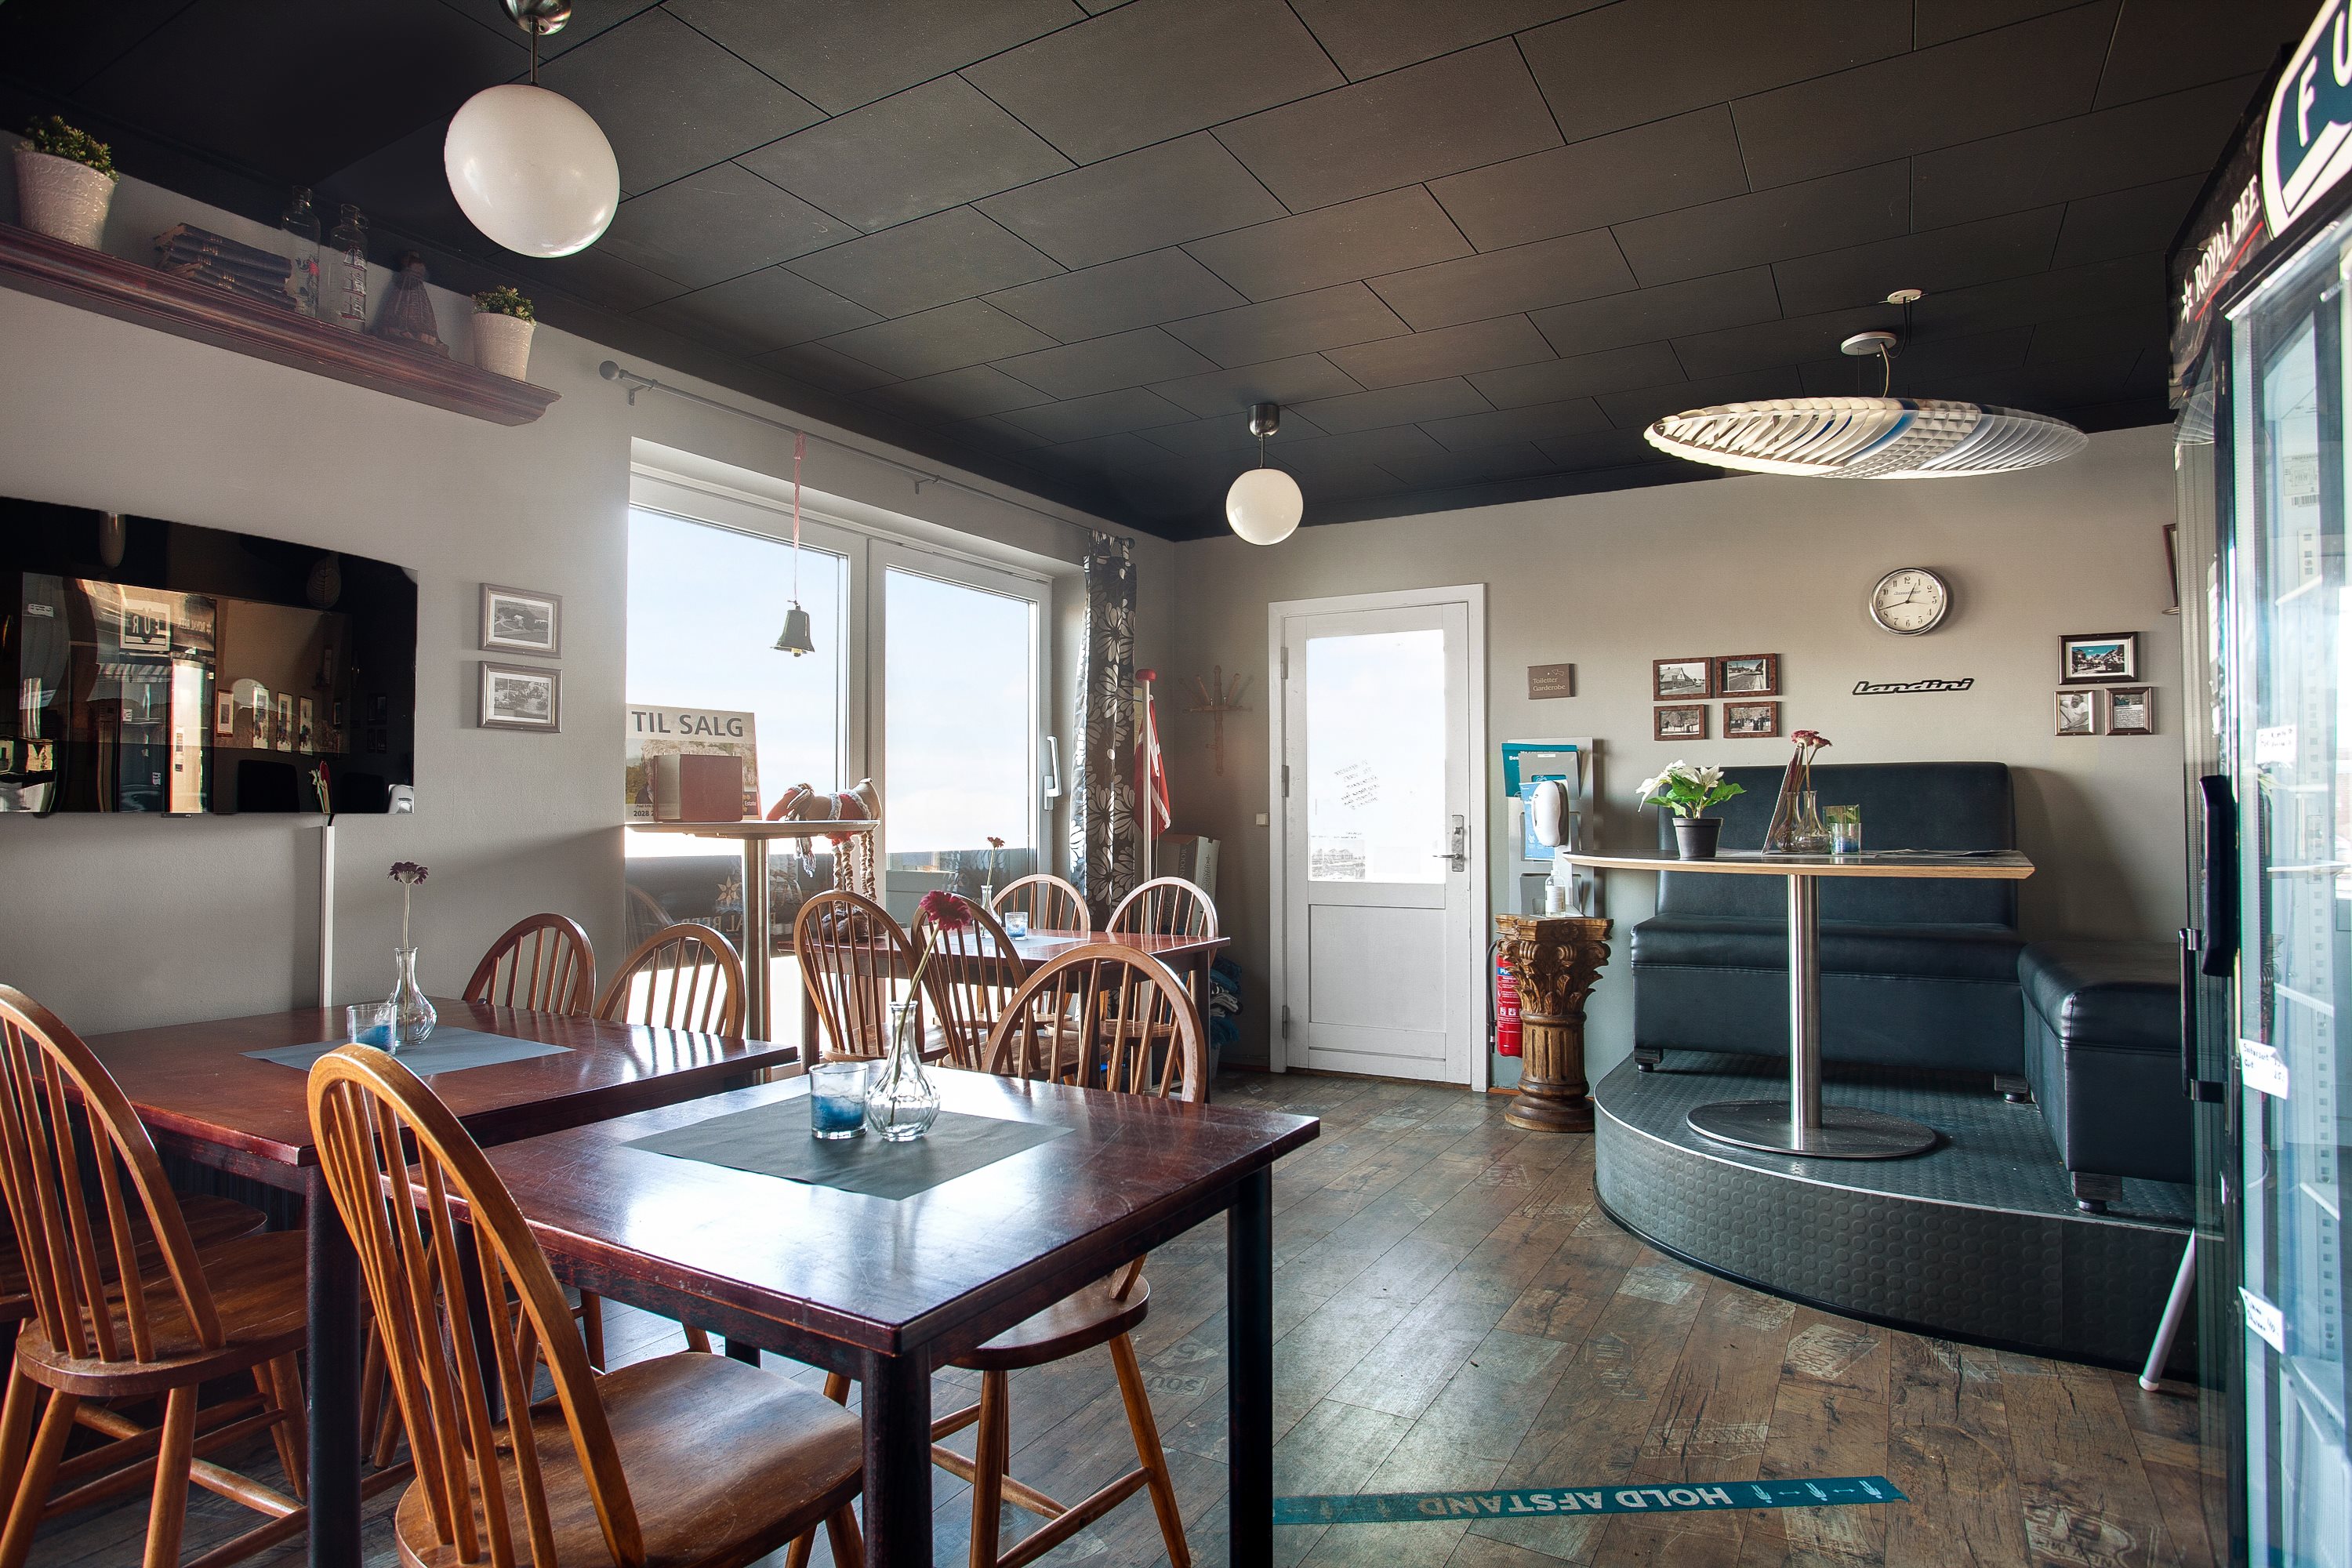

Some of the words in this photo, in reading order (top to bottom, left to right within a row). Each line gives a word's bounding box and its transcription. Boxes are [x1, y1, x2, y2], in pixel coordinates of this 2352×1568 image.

[2194, 221, 2232, 303] ROYAL
[631, 711, 671, 733] TIL
[679, 714, 744, 737] SALG
[1417, 1491, 1603, 1515] AFSTAND
[1614, 1486, 1734, 1508] HOLD
